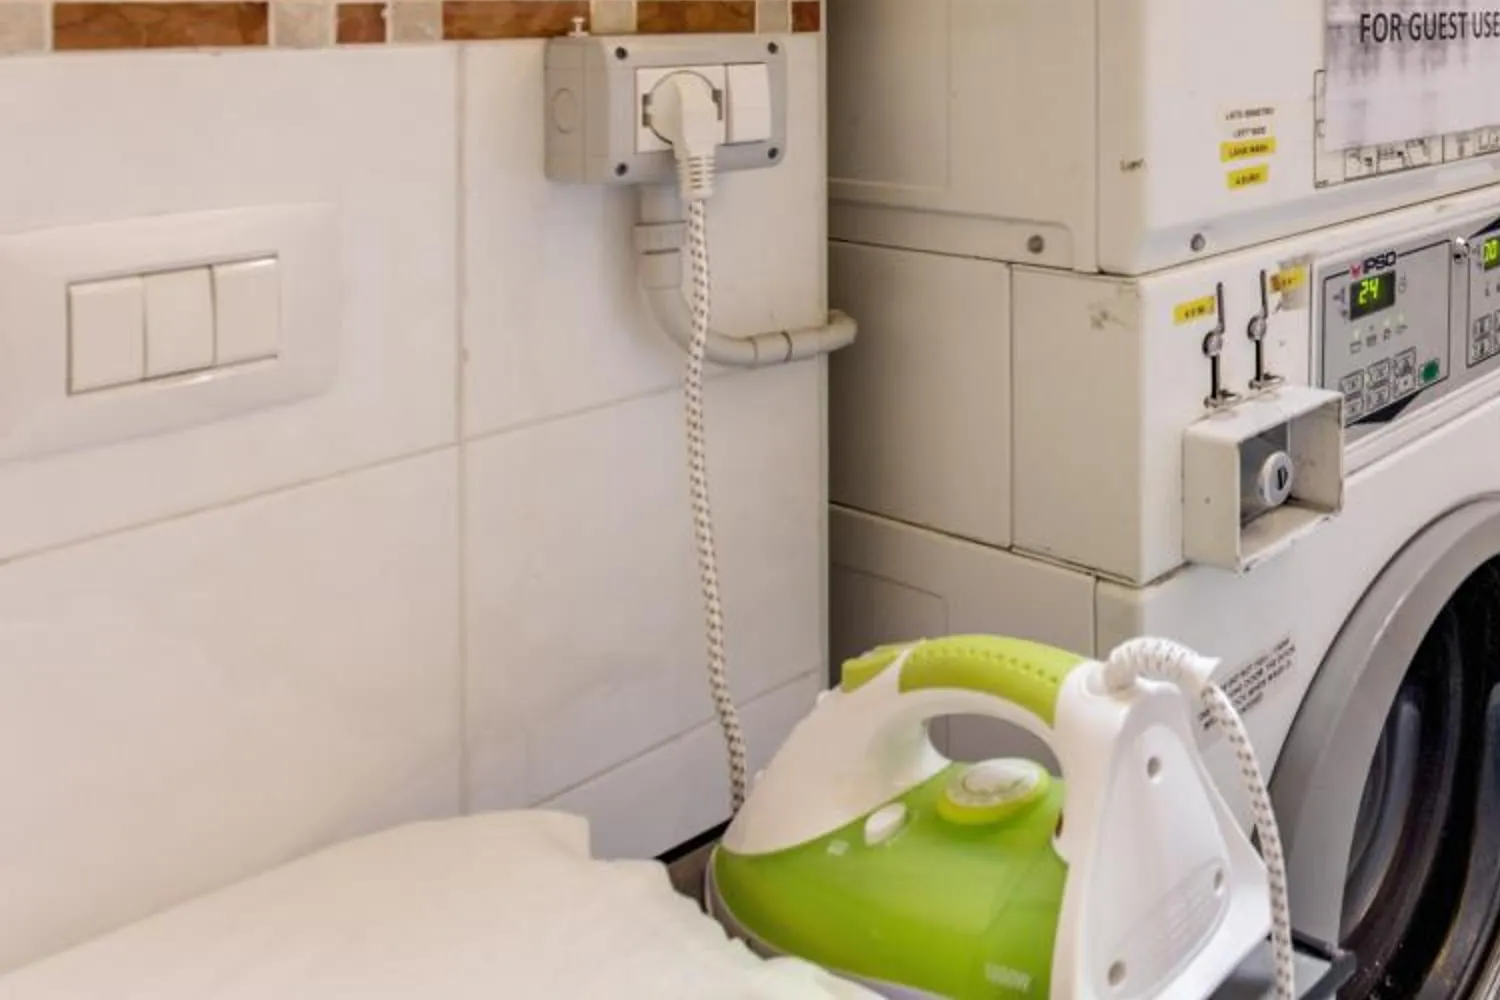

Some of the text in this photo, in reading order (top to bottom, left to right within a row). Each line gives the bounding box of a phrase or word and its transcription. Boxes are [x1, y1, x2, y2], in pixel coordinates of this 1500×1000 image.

[1360, 12, 1402, 44] FOR
[1408, 11, 1468, 41] GUEST
[1358, 277, 1380, 305] 24
